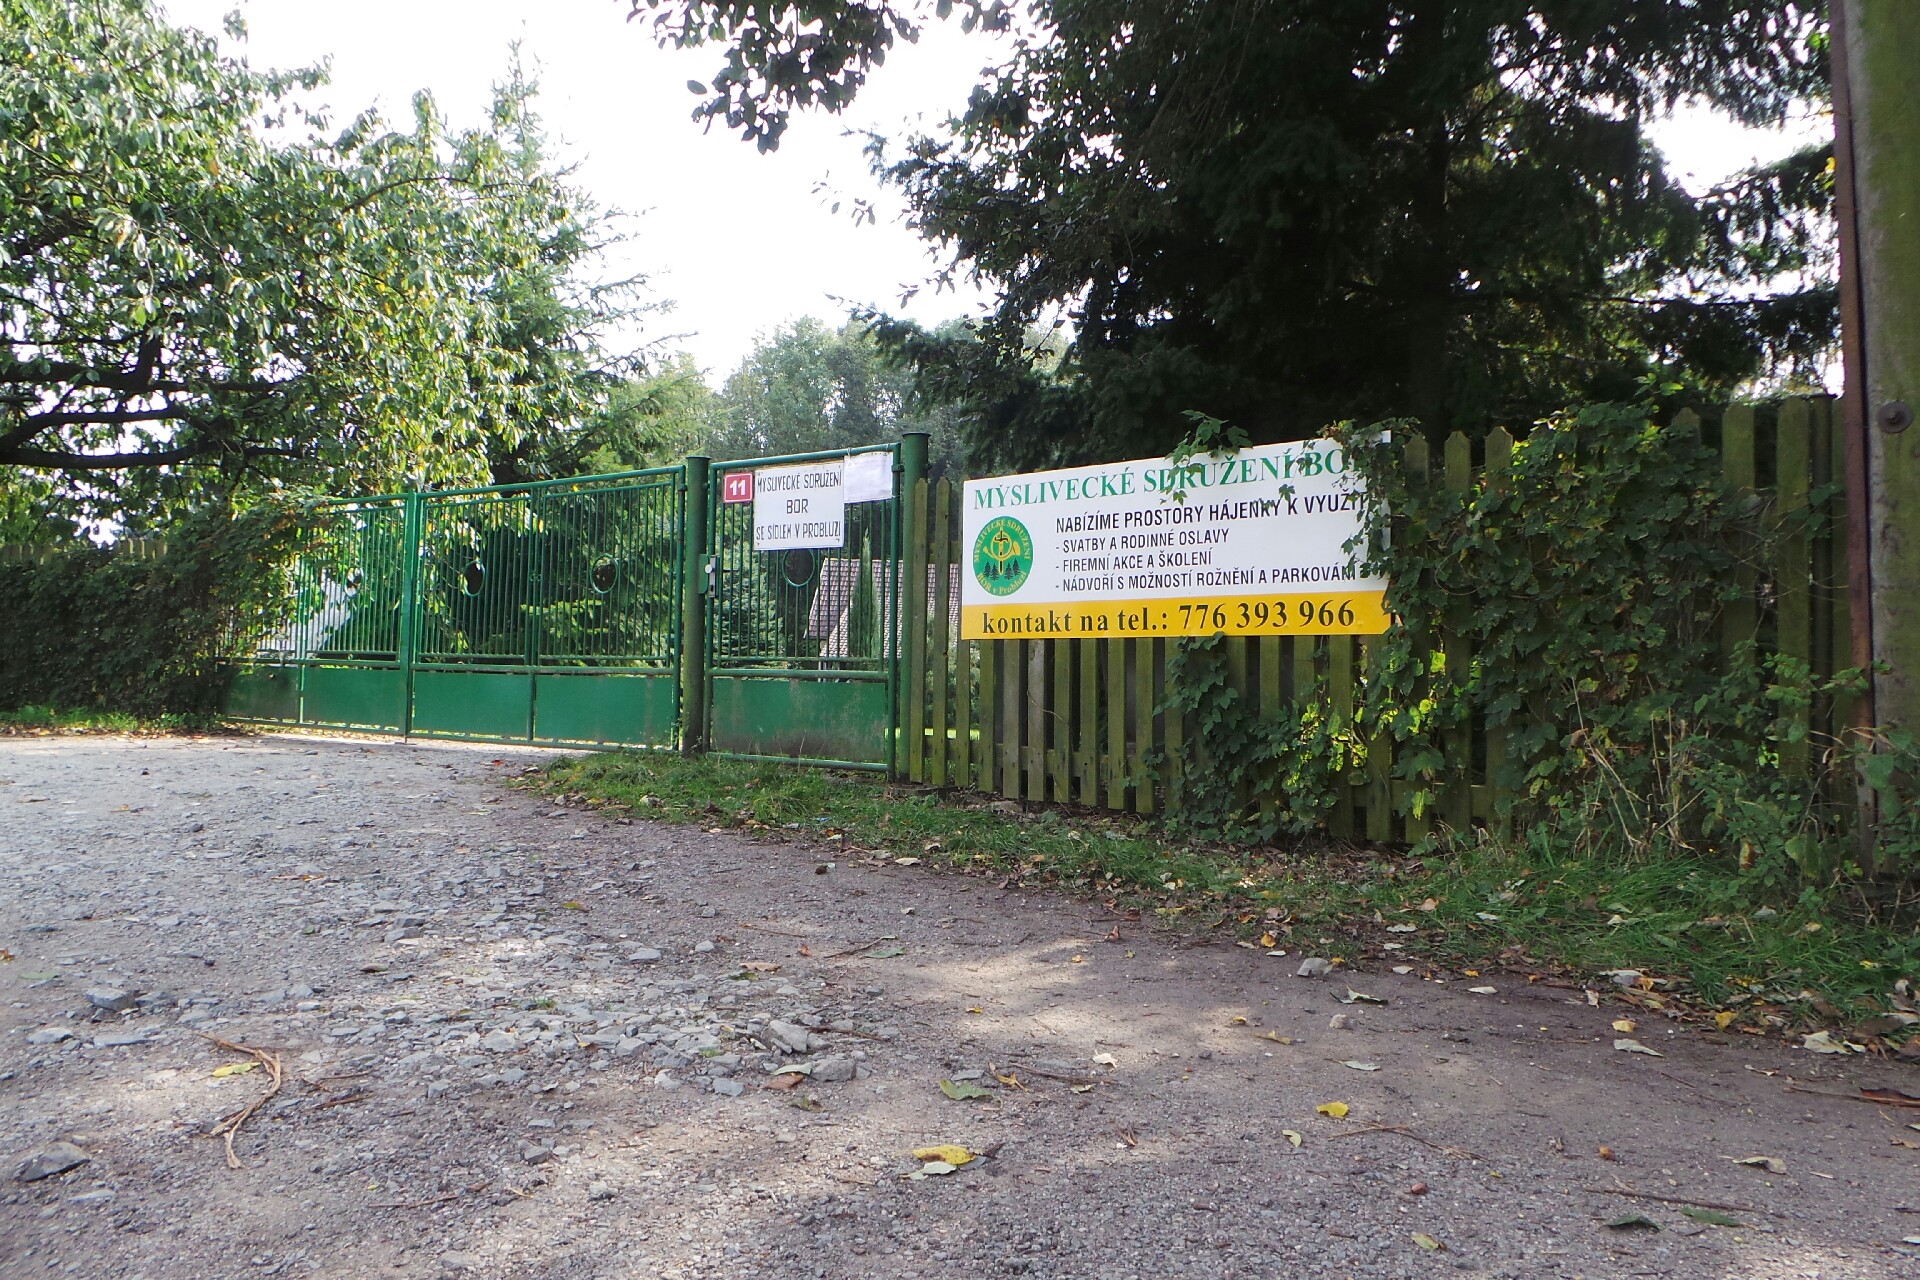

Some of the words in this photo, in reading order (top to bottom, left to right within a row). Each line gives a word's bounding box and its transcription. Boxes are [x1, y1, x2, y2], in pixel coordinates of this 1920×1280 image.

[729, 479, 746, 496] 11
[757, 472, 800, 493] MYSLIVECKÉ
[803, 469, 842, 489] SDRUŽENÍ
[974, 466, 1135, 511] MYSLIVECKÉ
[1143, 447, 1293, 493] SDRUŽENÍ
[1302, 448, 1362, 478] BO
[786, 498, 808, 514] BOR
[1056, 510, 1119, 533] NABÍZÍME
[1124, 505, 1204, 528] PROSTORY
[1209, 498, 1281, 521] HÁJENKY
[1287, 497, 1298, 515] K
[756, 526, 764, 540] SE
[767, 523, 792, 540] SÍDLEM
[795, 523, 800, 538] V
[802, 520, 841, 538] PROBLUZI
[1062, 537, 1106, 554] SVATBY
[1109, 536, 1117, 550] A
[1121, 528, 1175, 549] RODINNÉ
[1178, 528, 1230, 546] OSLAVY
[1062, 553, 1111, 572] FIREMNÍ
[1113, 555, 1144, 570] AKCE
[1146, 554, 1155, 568] A
[1158, 547, 1212, 568] ŠKOLENÍ
[1062, 573, 1115, 592] NÁDVOŘÍ
[1117, 576, 1125, 590] S
[1128, 569, 1194, 590] MOŽNOSTÍ
[1196, 565, 1256, 587] ROŽNĚNÍ
[1258, 569, 1268, 584] A
[982, 610, 1072, 633] kontakt
[1079, 614, 1108, 631] na
[1117, 607, 1168, 631] tel.:
[1178, 603, 1227, 629] 776
[1236, 601, 1288, 628] 393
[1299, 599, 1355, 627] 966
